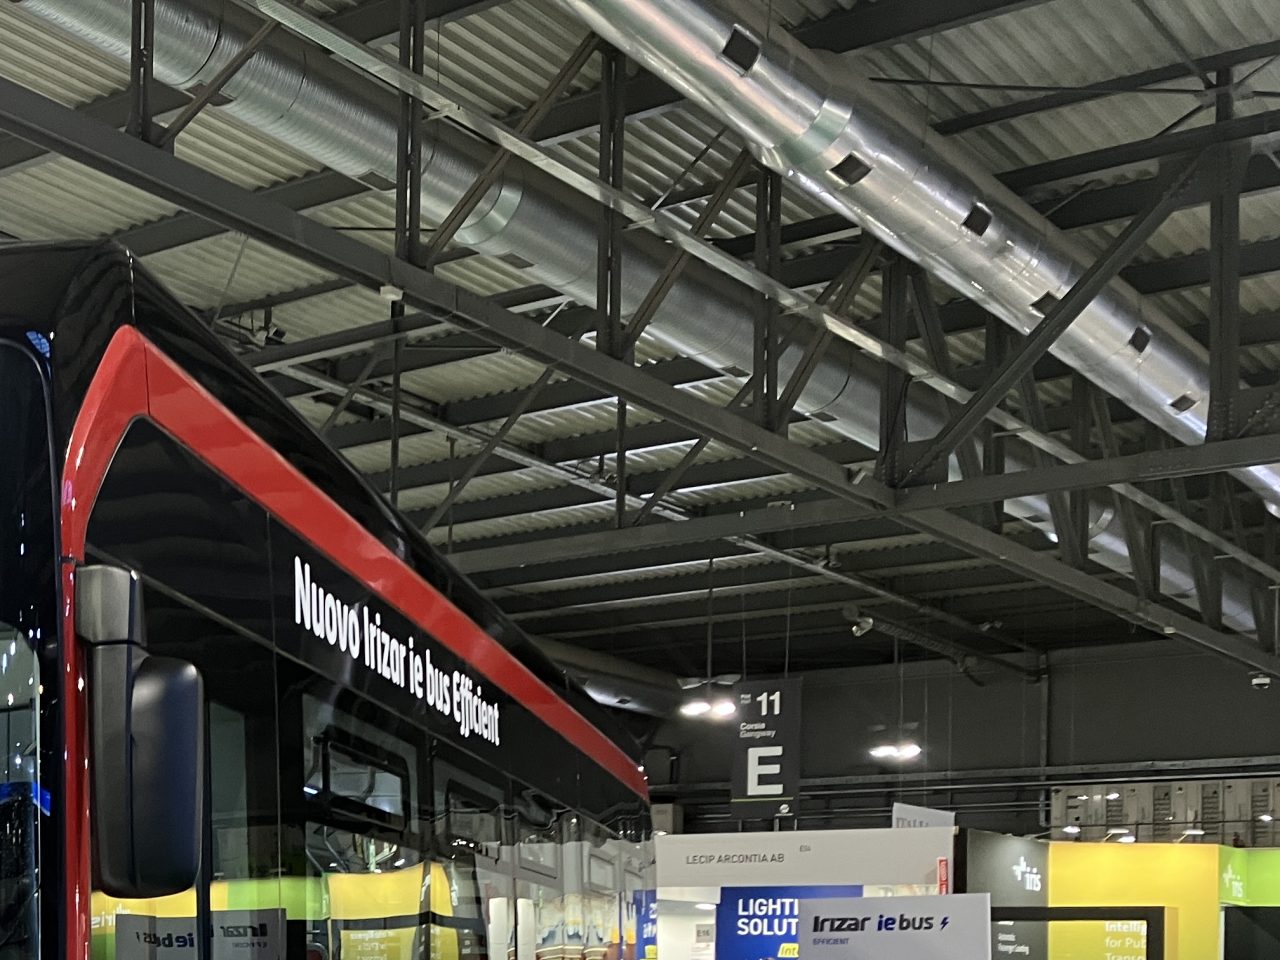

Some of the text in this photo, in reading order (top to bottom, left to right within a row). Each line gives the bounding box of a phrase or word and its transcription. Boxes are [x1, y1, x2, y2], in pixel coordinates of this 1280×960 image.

[294, 556, 500, 747] Nuovo Irizar ie bus Efficient
[756, 691, 780, 716] 11
[747, 746, 784, 796] E
[686, 853, 785, 865] LECIP ARCONTIA AB
[812, 915, 871, 932] Irizar
[1105, 937, 1122, 948] for
